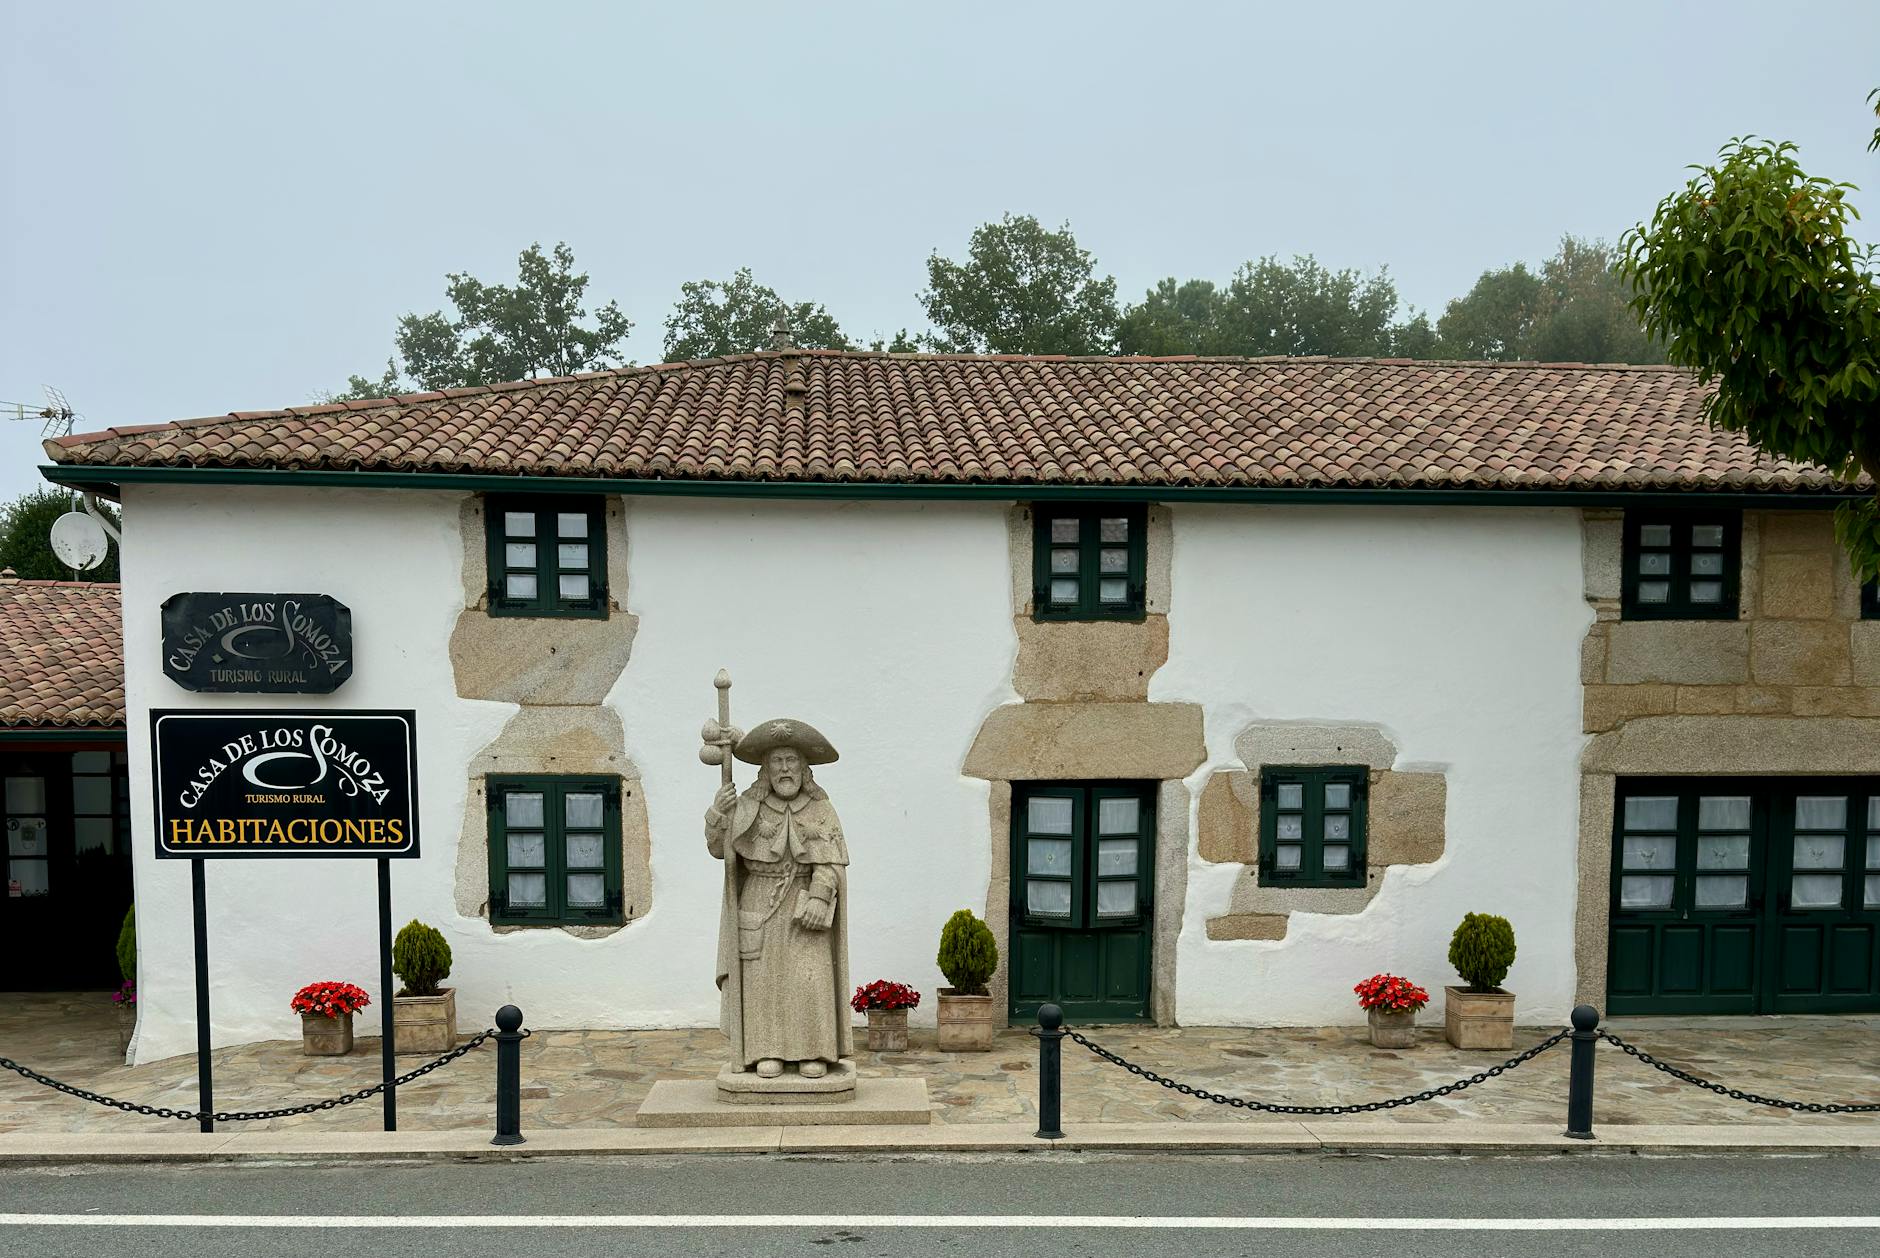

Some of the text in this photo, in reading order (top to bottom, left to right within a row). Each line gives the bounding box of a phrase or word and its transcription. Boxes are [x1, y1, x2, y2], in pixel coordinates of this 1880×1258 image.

[169, 600, 348, 675] CASA DE LOS SOMOZA
[210, 669, 307, 684] TURISMO RURAL
[180, 724, 392, 808] CASA DE LOS SOMOZA
[245, 794, 325, 803] TURISMO RURAL
[170, 818, 404, 844] HABITACIONES
